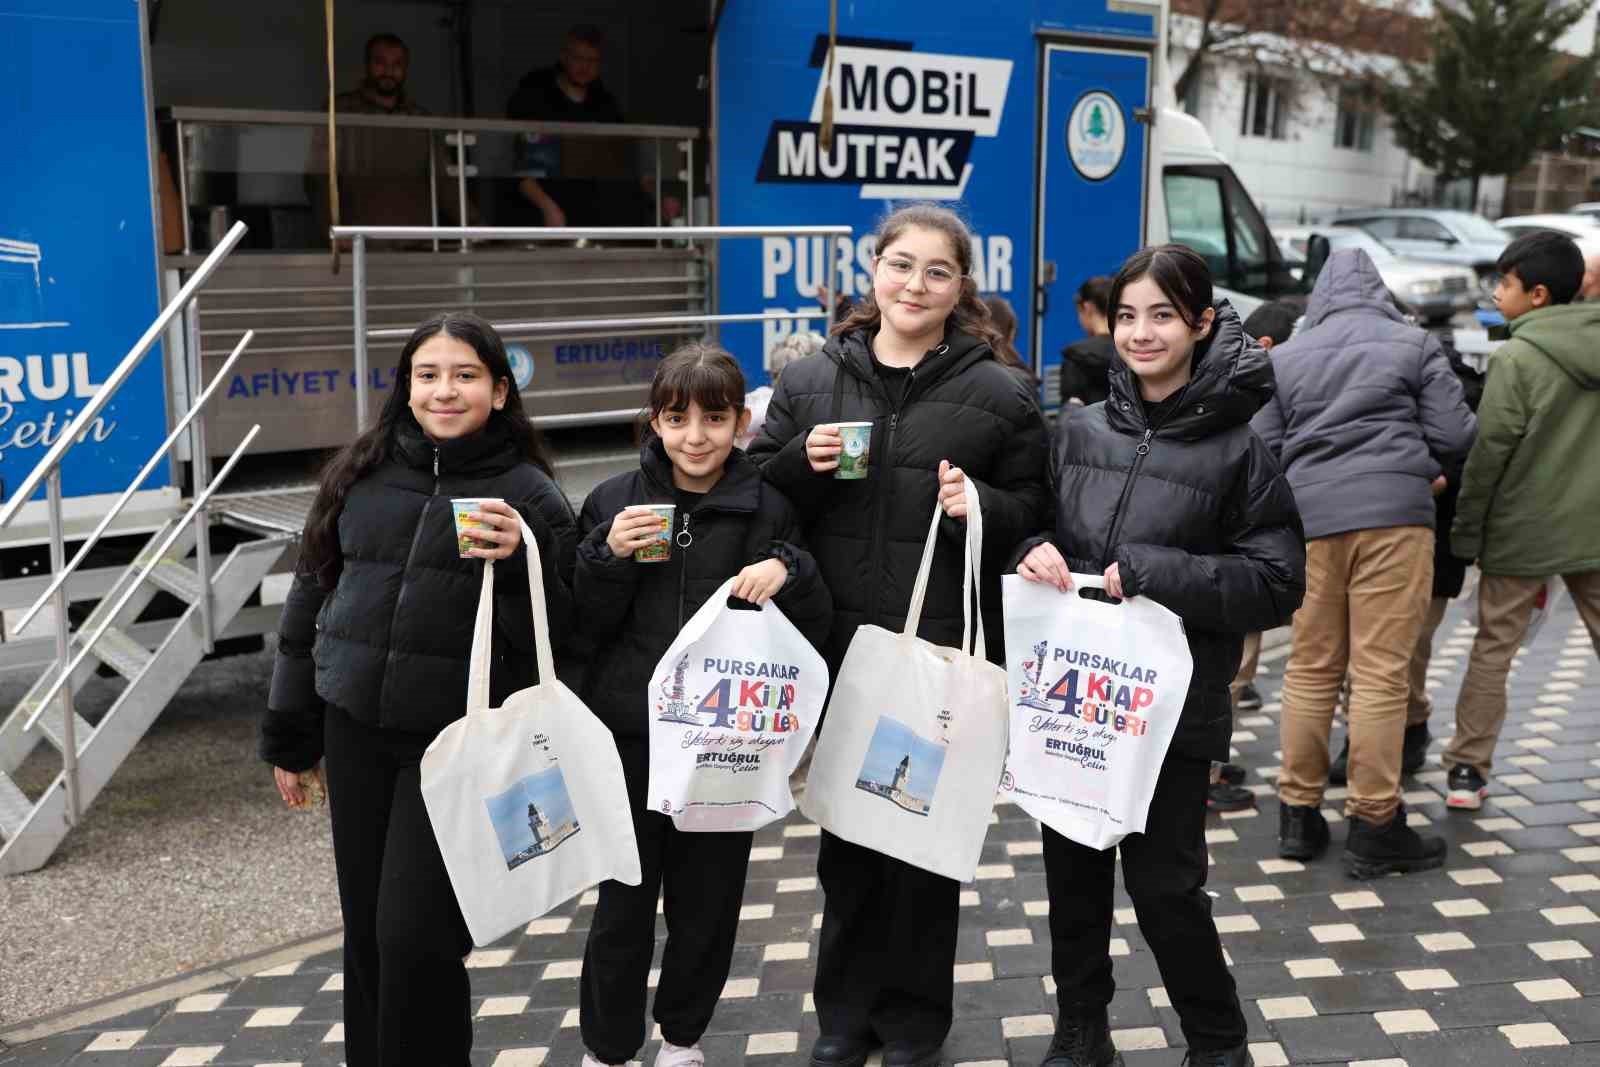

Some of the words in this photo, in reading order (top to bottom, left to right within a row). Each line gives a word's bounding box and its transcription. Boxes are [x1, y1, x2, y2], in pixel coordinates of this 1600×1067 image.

[777, 130, 955, 181] MUTFAK
[227, 368, 340, 399] AFİYET
[1054, 647, 1158, 685] PURSAKLAR
[696, 752, 761, 764] ERTUĞRUL
[1045, 737, 1107, 761] ERTUĞRUL
